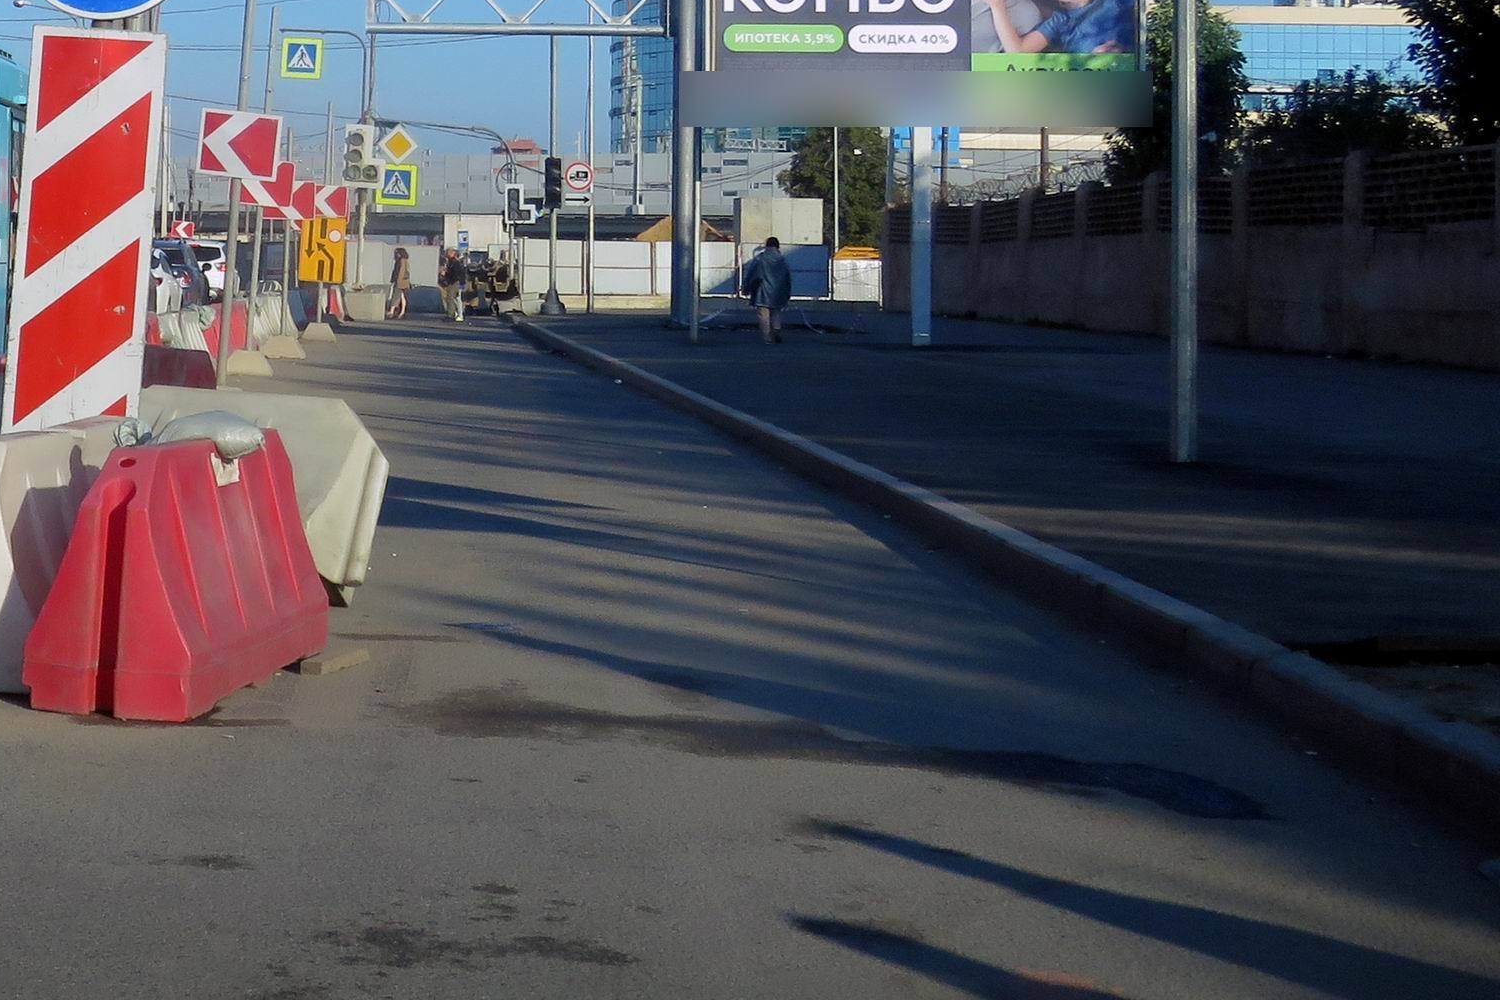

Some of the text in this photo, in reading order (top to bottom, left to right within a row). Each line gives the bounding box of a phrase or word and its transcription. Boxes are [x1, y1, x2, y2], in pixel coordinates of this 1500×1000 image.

[734, 33, 835, 46] ИПОТЕКА 3,9%
[859, 34, 949, 45] СКИДКА 40%
